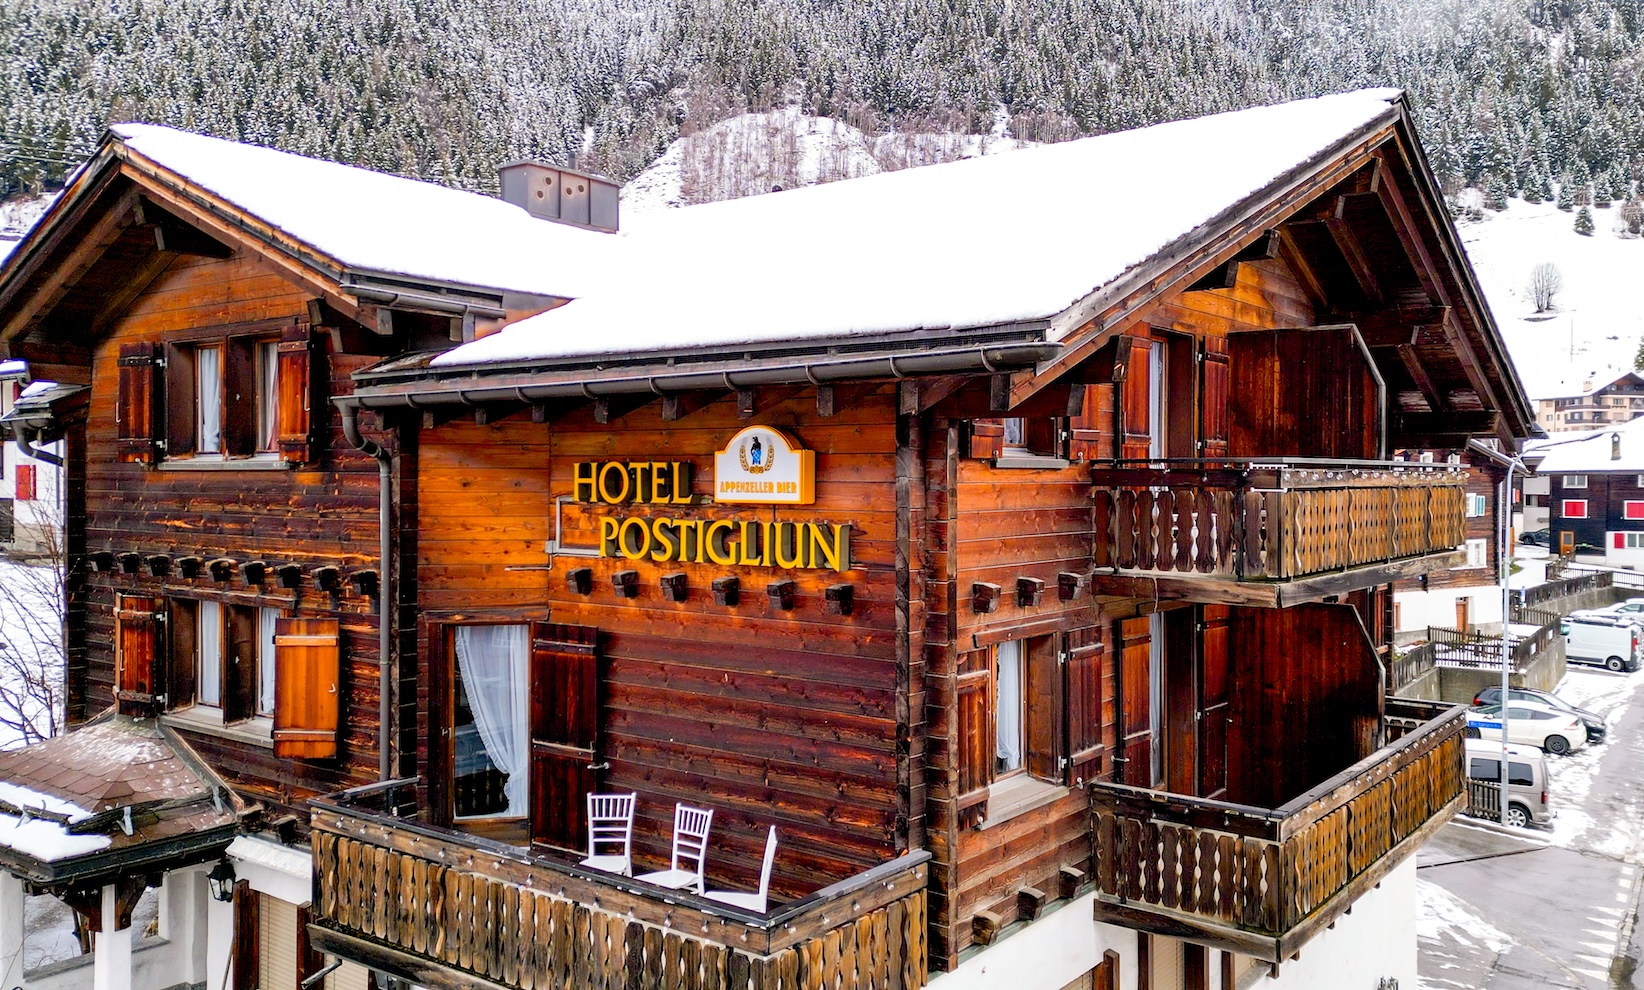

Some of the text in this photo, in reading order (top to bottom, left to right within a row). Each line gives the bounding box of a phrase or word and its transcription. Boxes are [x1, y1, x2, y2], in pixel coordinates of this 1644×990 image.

[573, 461, 693, 504] HOTEL
[719, 481, 797, 494] APPENZELLER BIER
[598, 516, 843, 573] POSTIGLIUN
